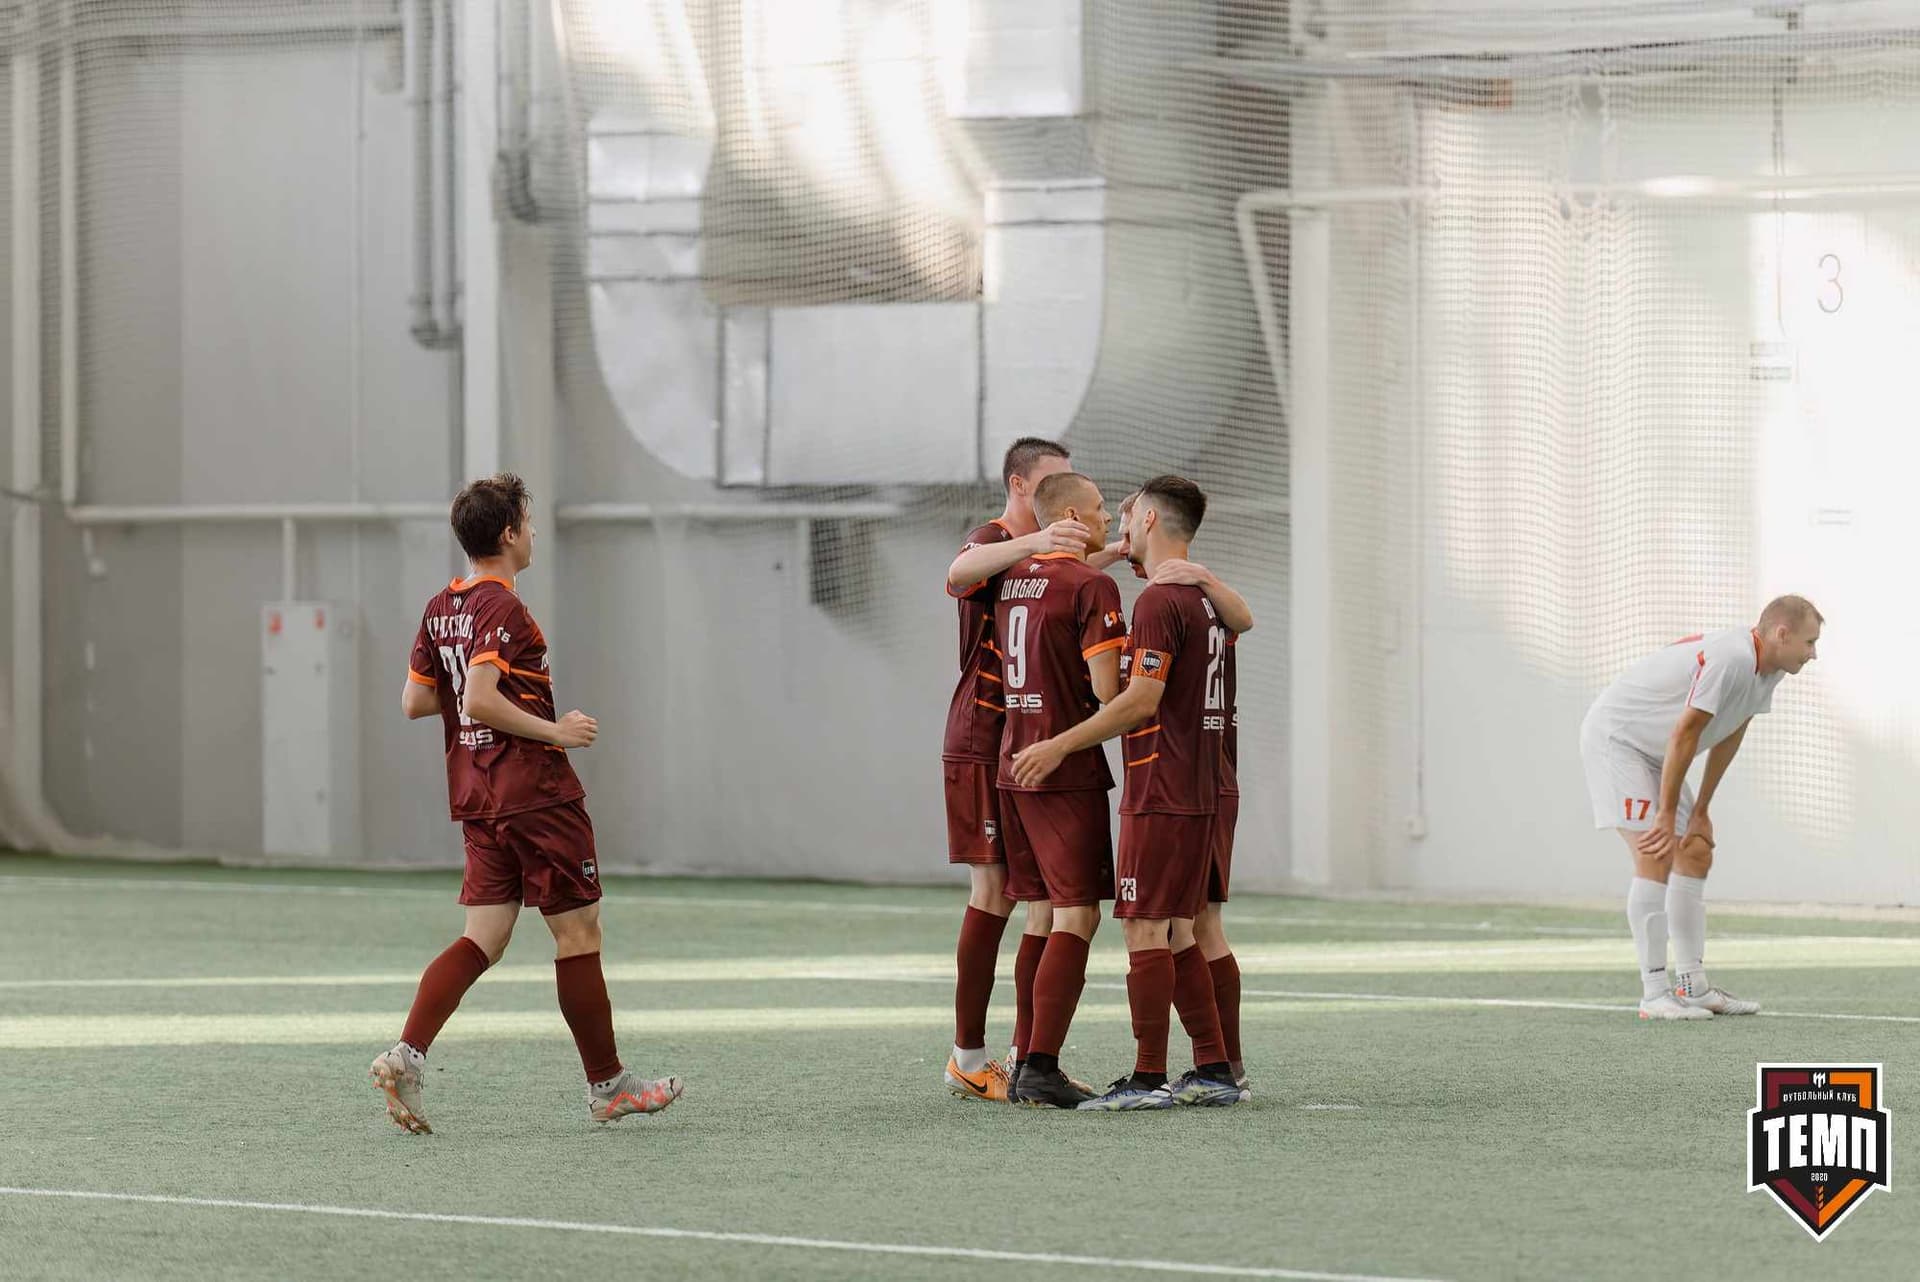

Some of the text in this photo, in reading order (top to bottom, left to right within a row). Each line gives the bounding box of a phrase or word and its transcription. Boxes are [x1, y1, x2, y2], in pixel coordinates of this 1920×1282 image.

[1817, 254, 1844, 314] 3
[1001, 578, 1049, 600] ШИБАЕВ
[1007, 604, 1029, 689] 9
[1625, 798, 1651, 820] 17
[1121, 878, 1136, 901] 23
